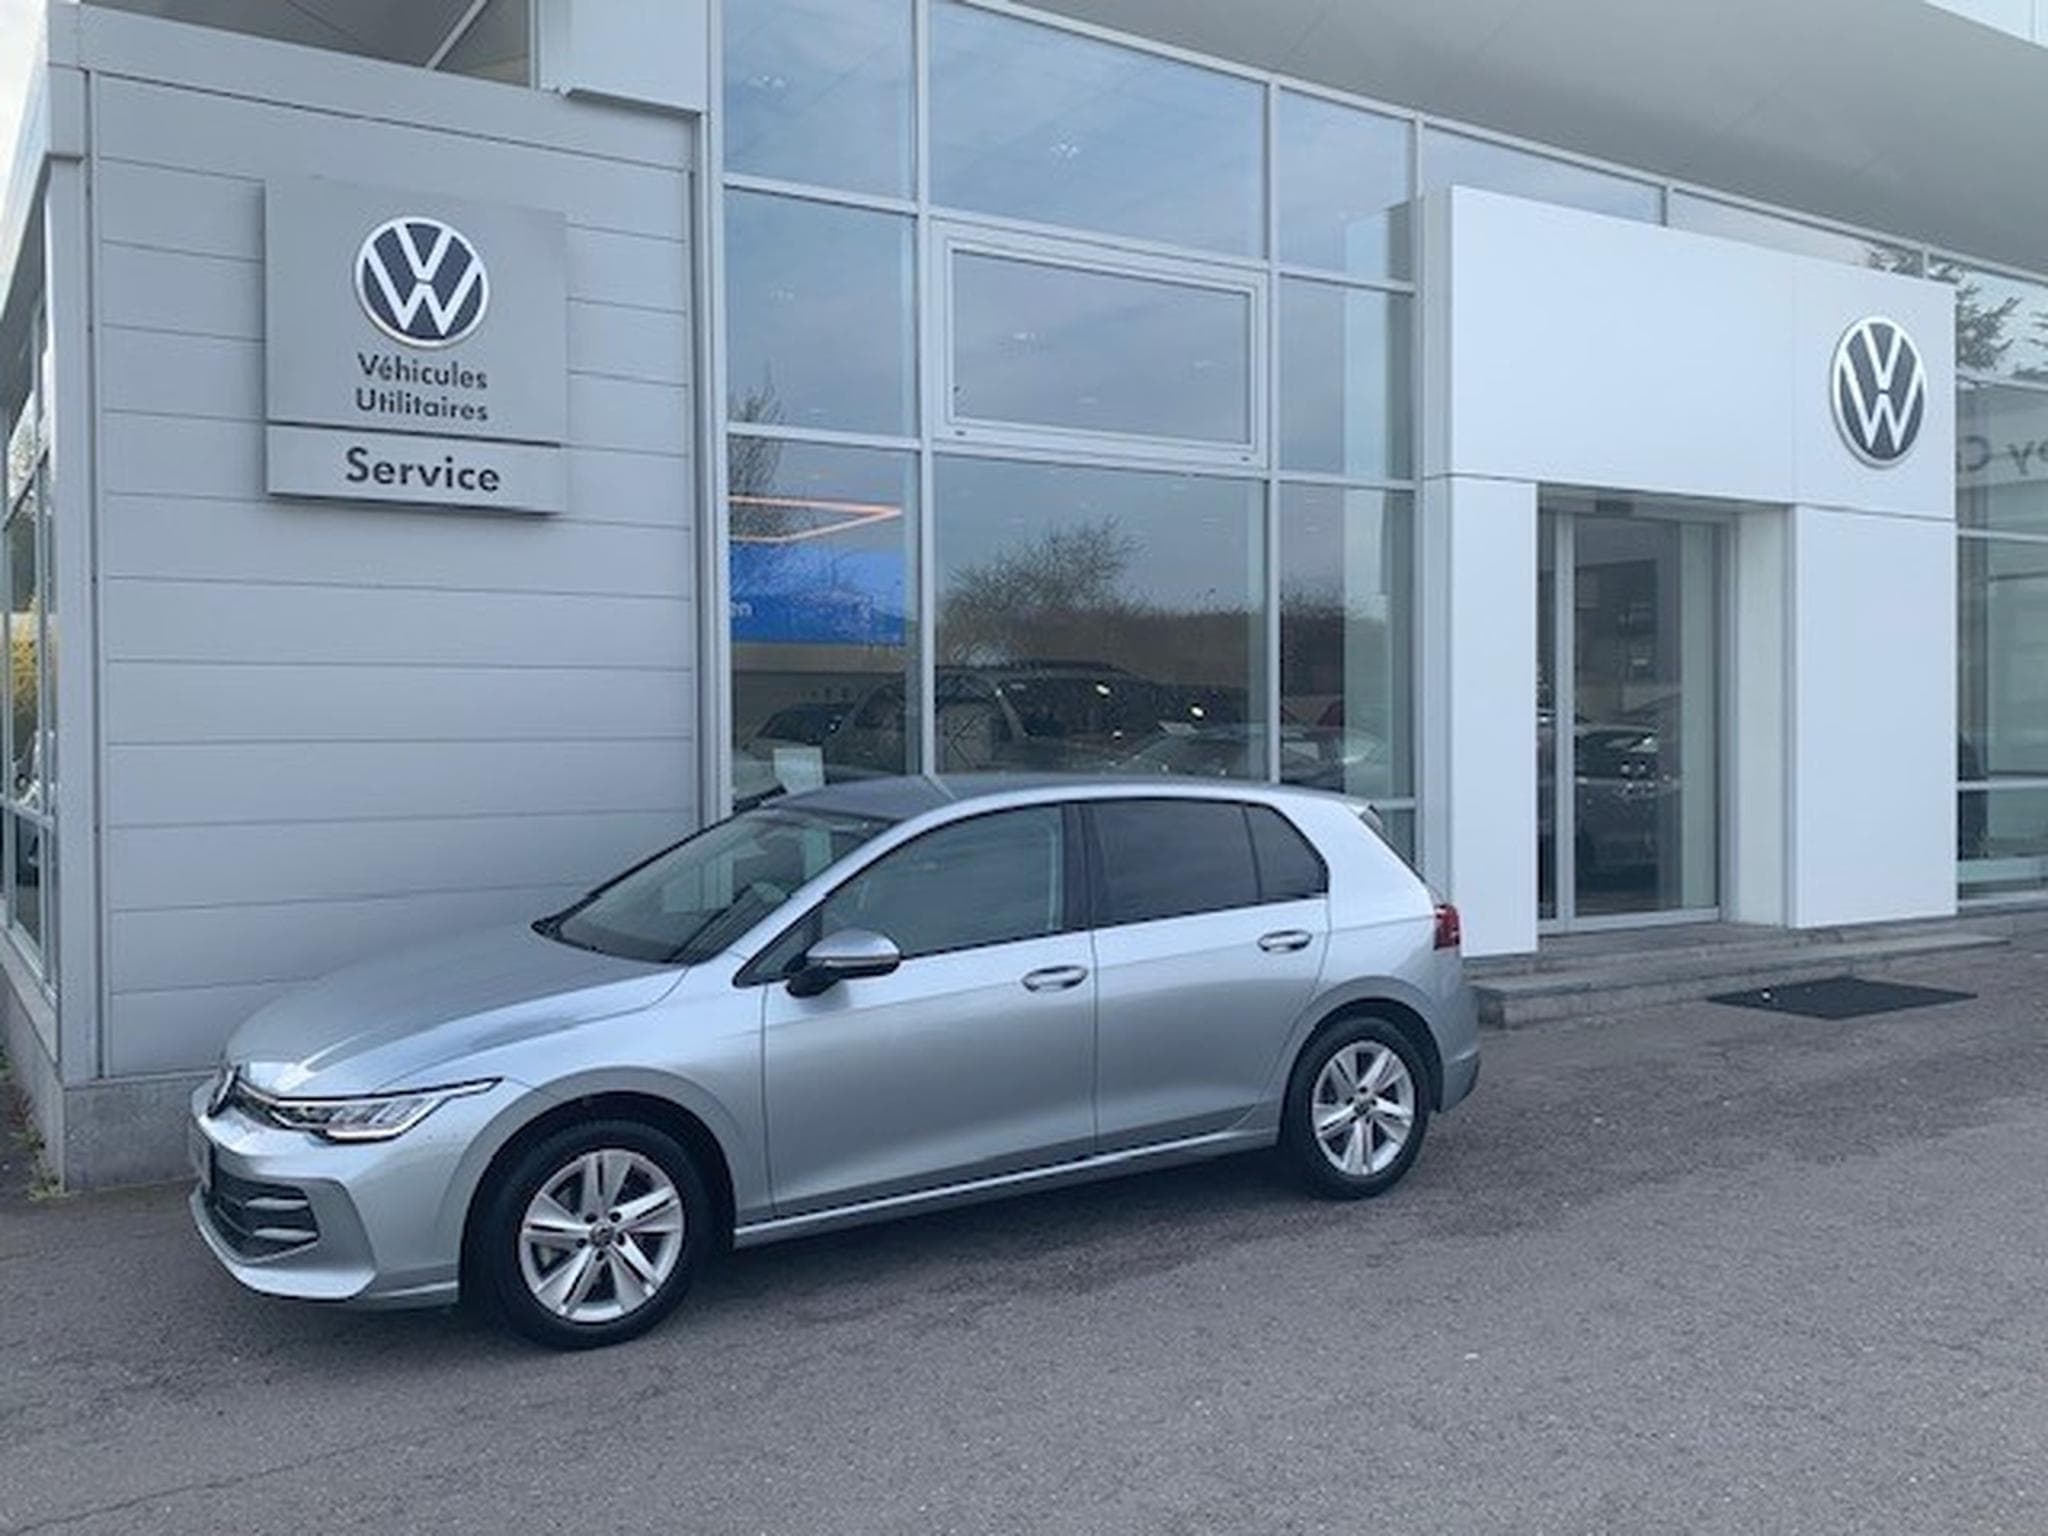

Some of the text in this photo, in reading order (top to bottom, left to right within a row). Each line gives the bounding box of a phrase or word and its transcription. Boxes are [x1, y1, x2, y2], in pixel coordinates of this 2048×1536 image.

[357, 352, 488, 389] Véhicules
[356, 387, 489, 421] Utilitaires
[346, 446, 501, 492] Service
